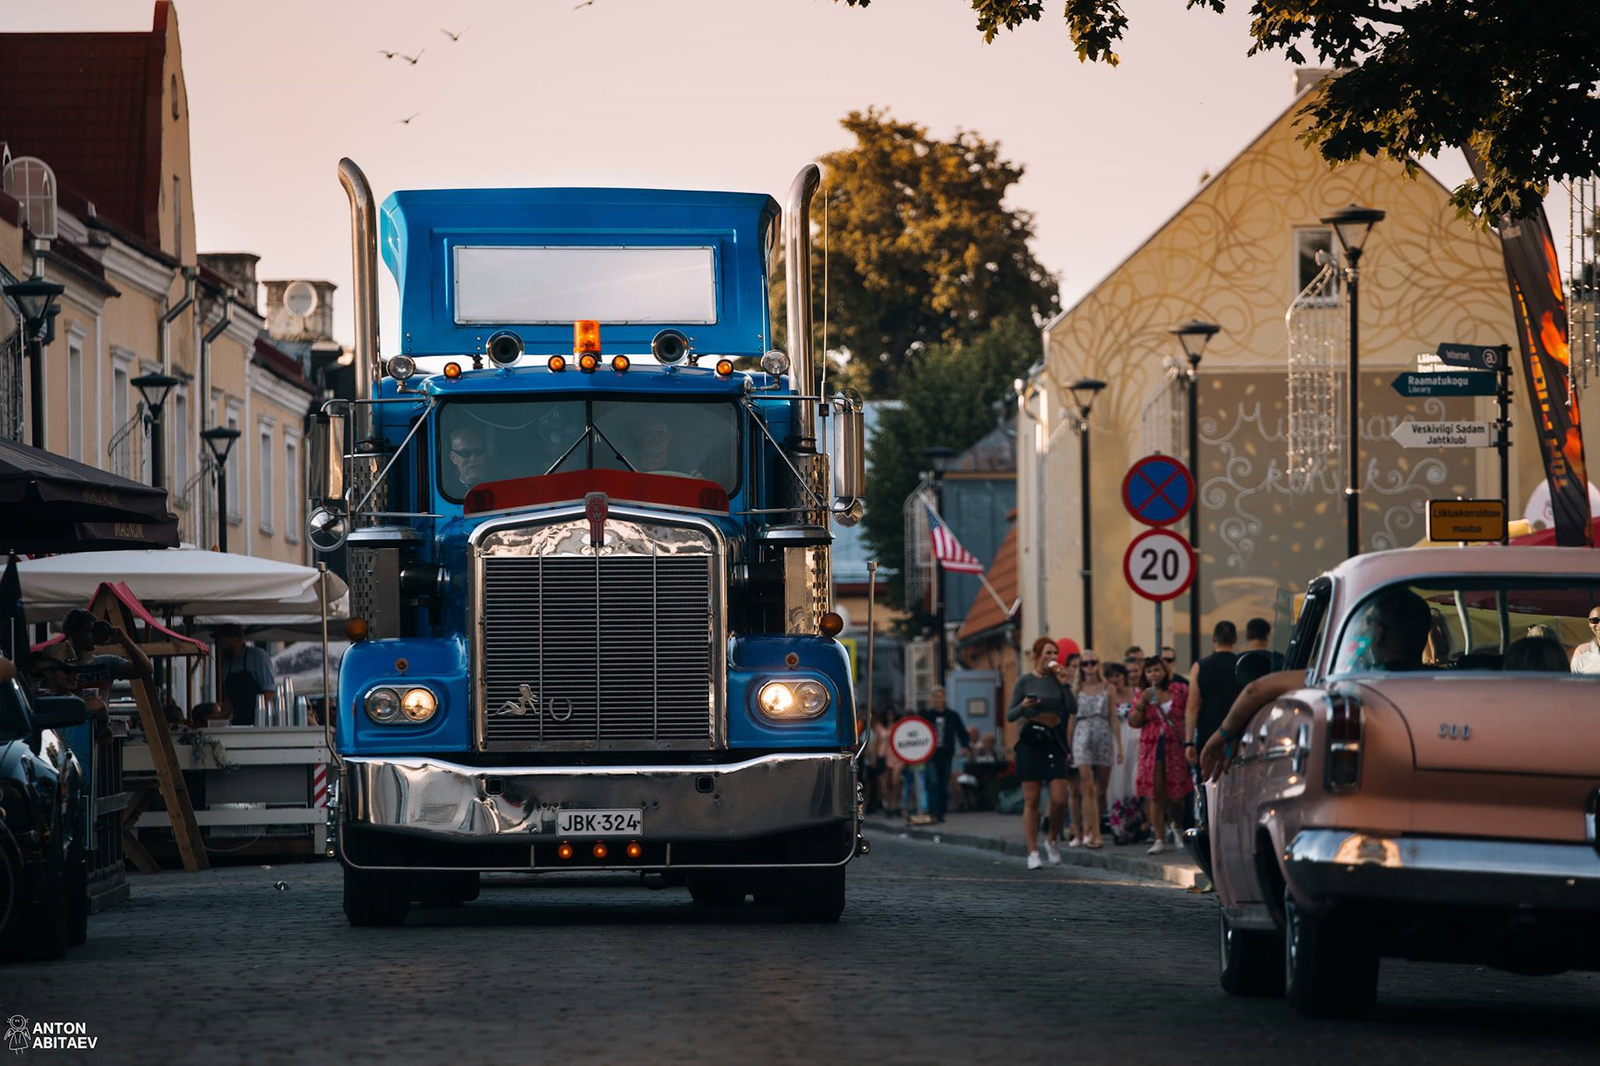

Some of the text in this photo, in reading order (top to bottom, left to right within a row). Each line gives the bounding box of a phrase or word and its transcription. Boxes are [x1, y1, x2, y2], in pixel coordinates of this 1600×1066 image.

[1446, 349, 1471, 360] Internet
[1408, 376, 1469, 387] Raamatukogu
[1408, 386, 1431, 394] Library
[1411, 424, 1485, 435] Veskiviigi Sadam
[1427, 436, 1467, 444] Jahtklubi
[1140, 548, 1179, 581] 20
[562, 814, 638, 832] JBK-324
